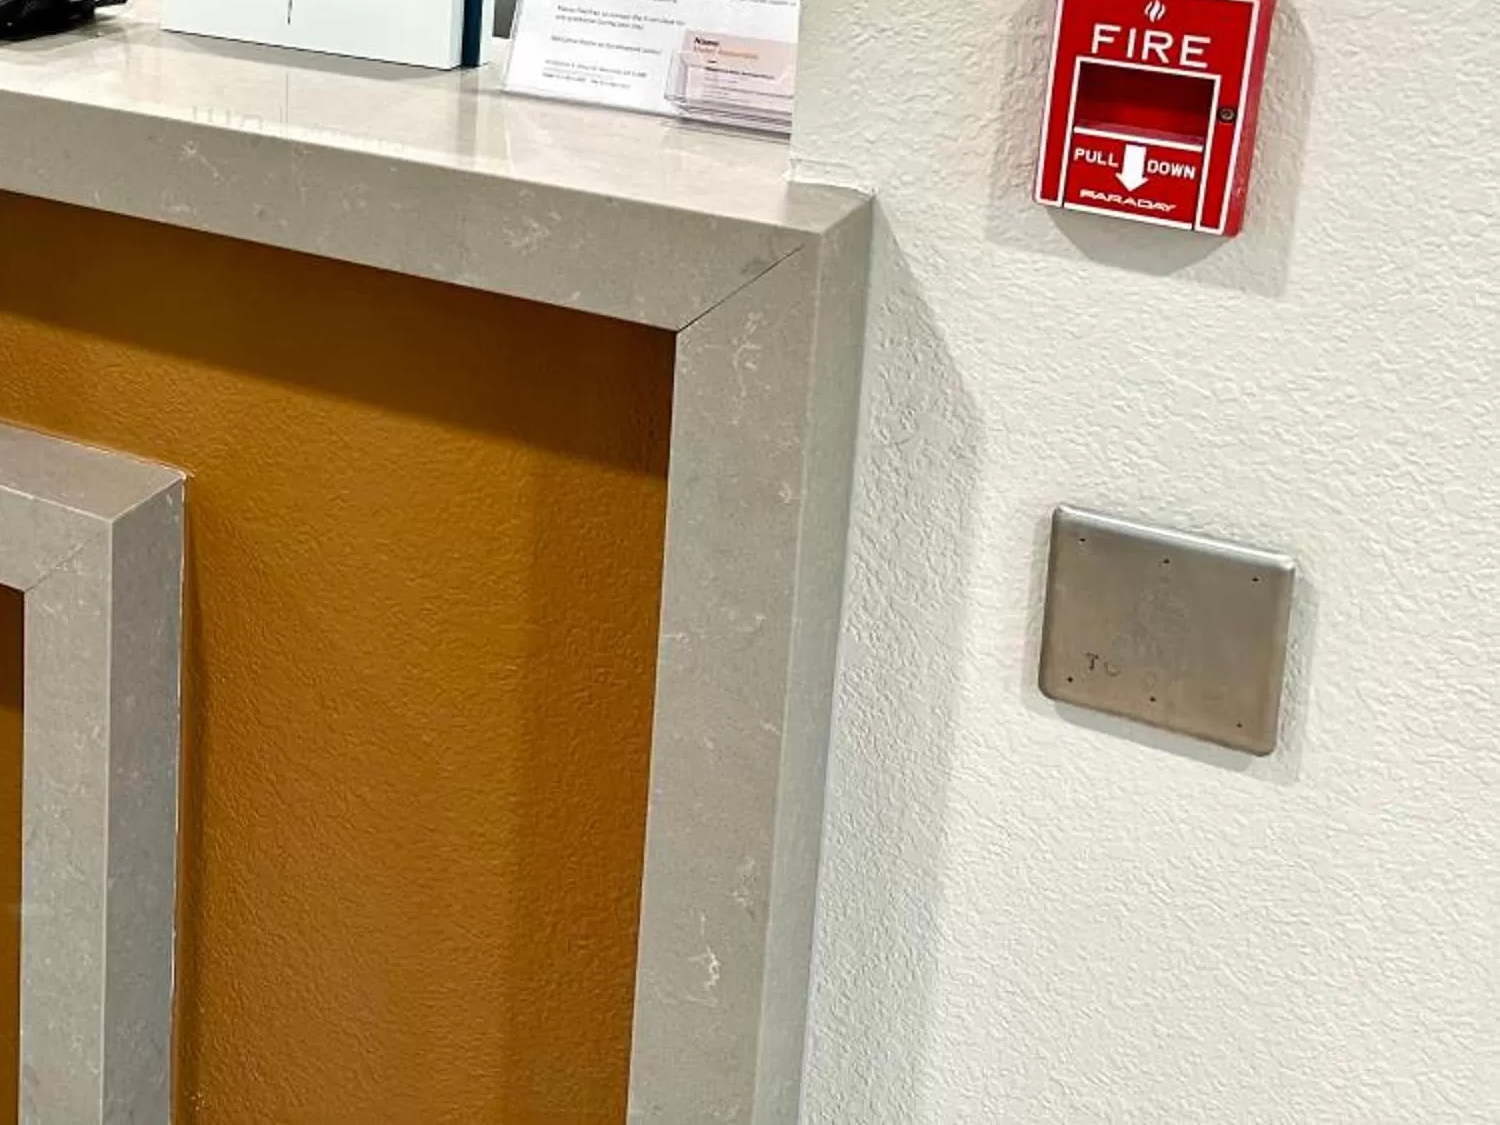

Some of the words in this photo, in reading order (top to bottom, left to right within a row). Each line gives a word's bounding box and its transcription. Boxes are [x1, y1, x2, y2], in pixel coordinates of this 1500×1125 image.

[1091, 23, 1212, 69] FIRE
[1073, 147, 1119, 168] PULL
[1146, 159, 1196, 180] DOWN
[1079, 188, 1178, 213] FARADAY
